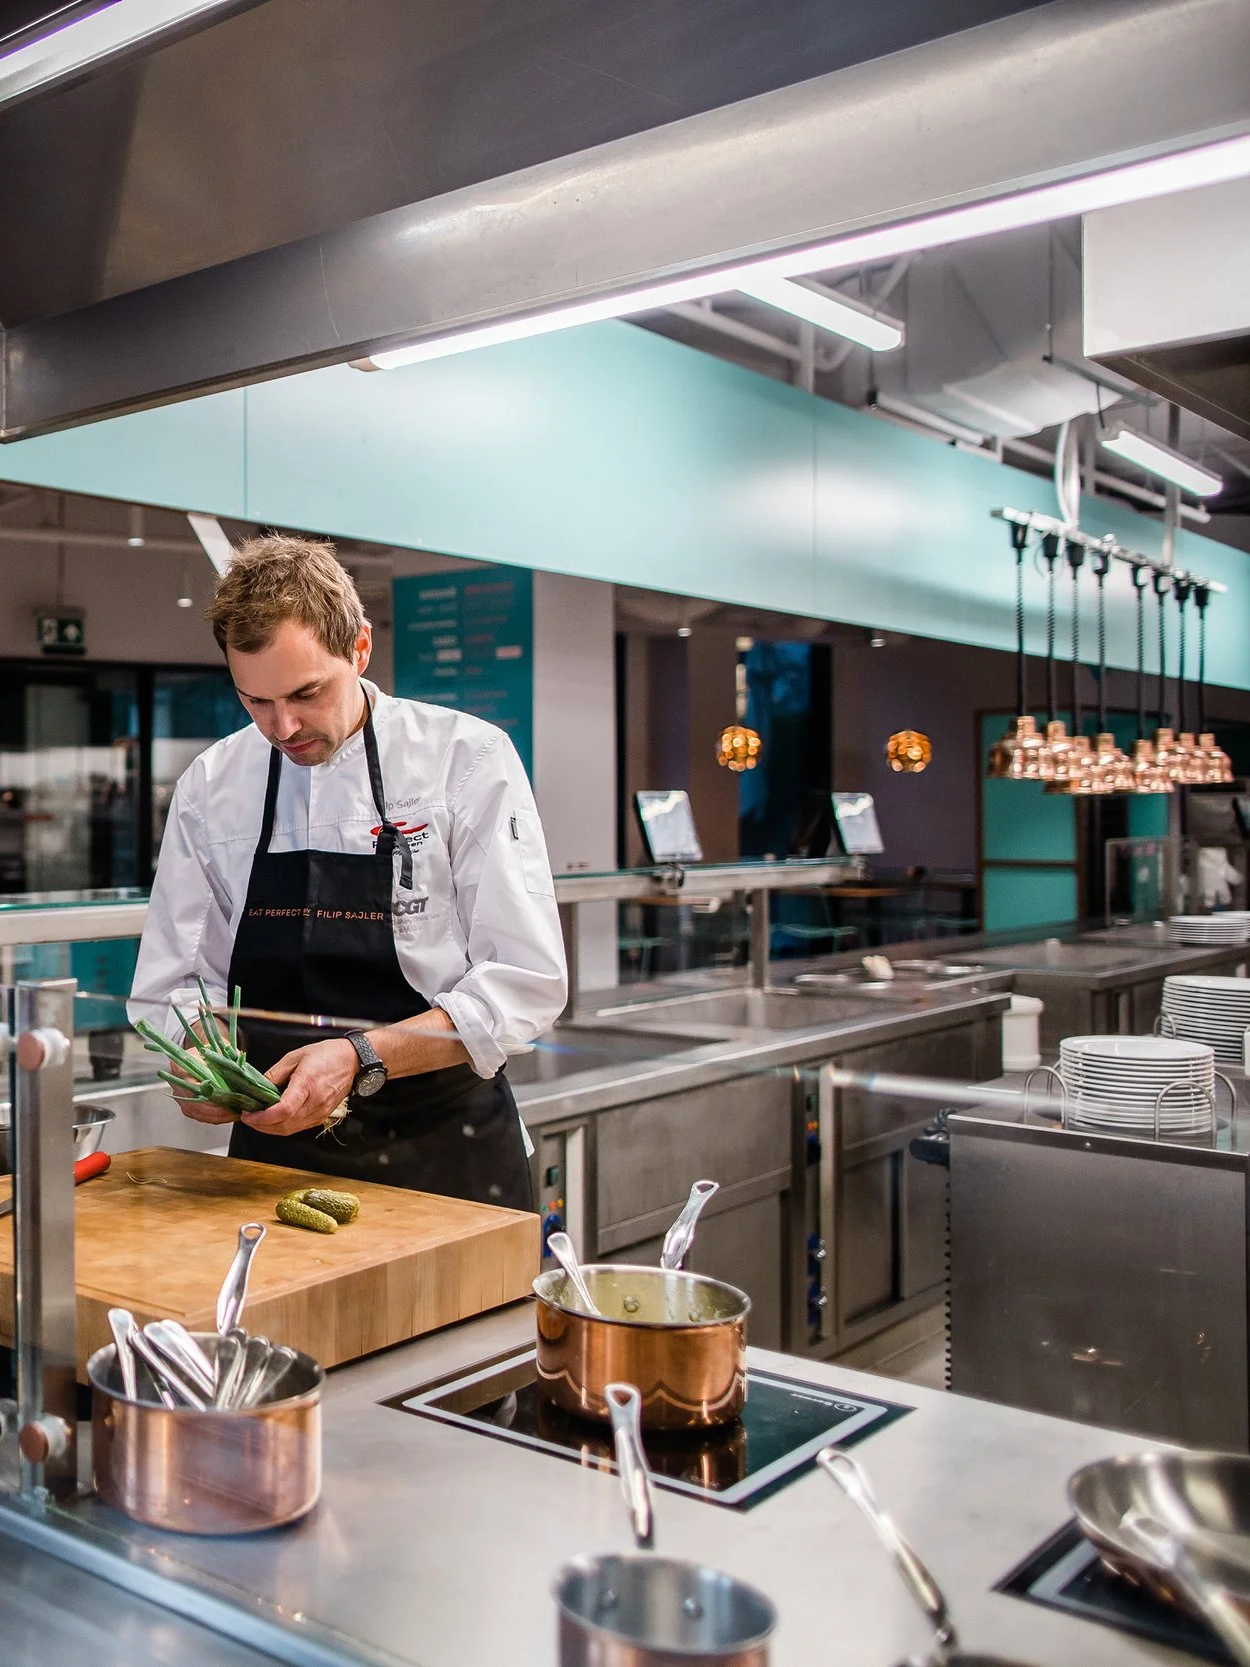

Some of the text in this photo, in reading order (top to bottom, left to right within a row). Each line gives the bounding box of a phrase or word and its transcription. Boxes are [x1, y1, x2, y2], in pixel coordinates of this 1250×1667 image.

[248, 908, 263, 917] EAT
[265, 908, 302, 917] PERFECT
[316, 909, 342, 919] FILIP
[344, 911, 385, 921] SAJLER
